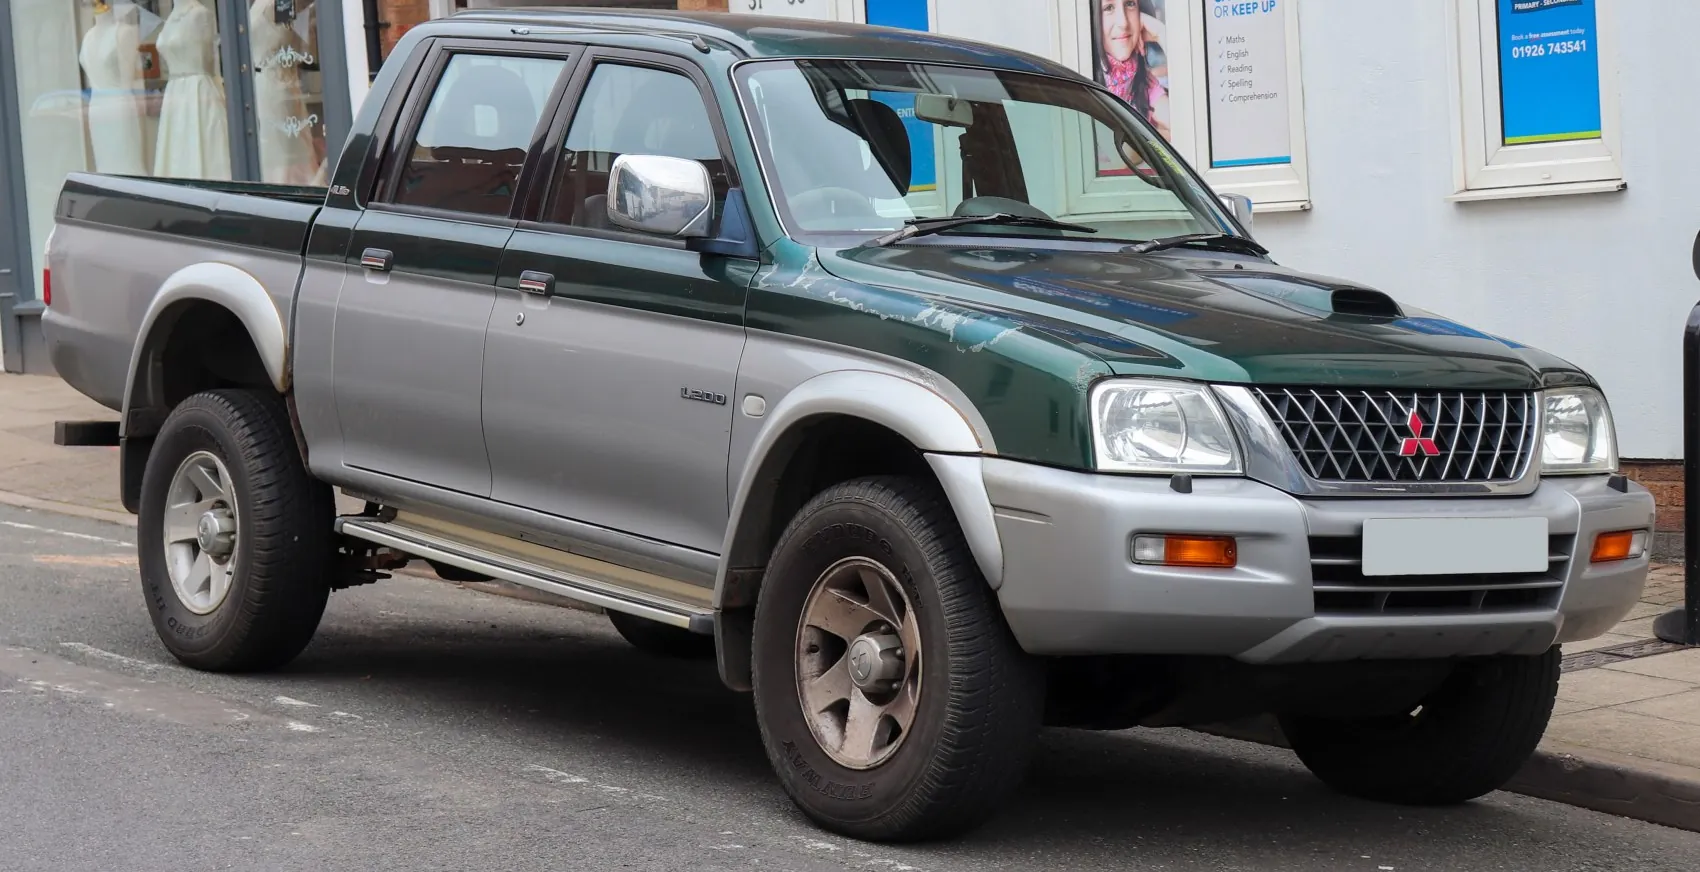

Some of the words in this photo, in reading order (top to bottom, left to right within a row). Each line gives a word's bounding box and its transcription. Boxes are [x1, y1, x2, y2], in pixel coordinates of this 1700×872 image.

[1214, 5, 1228, 18] OR
[1231, 2, 1258, 16] KEEP
[1261, 0, 1276, 13] UP
[1514, 1, 1539, 10] PRIMARY
[1528, 31, 1540, 39] free
[1540, 29, 1569, 38] assessment
[1570, 26, 1585, 35] today
[1226, 33, 1246, 45] Maths
[1226, 48, 1249, 60] English
[1512, 44, 1545, 58] 01926
[1547, 40, 1586, 55] 743541
[1227, 64, 1253, 74] Reading
[1227, 78, 1253, 90] Spelling
[1228, 90, 1278, 103] Comprehension
[680, 386, 726, 406] L200
